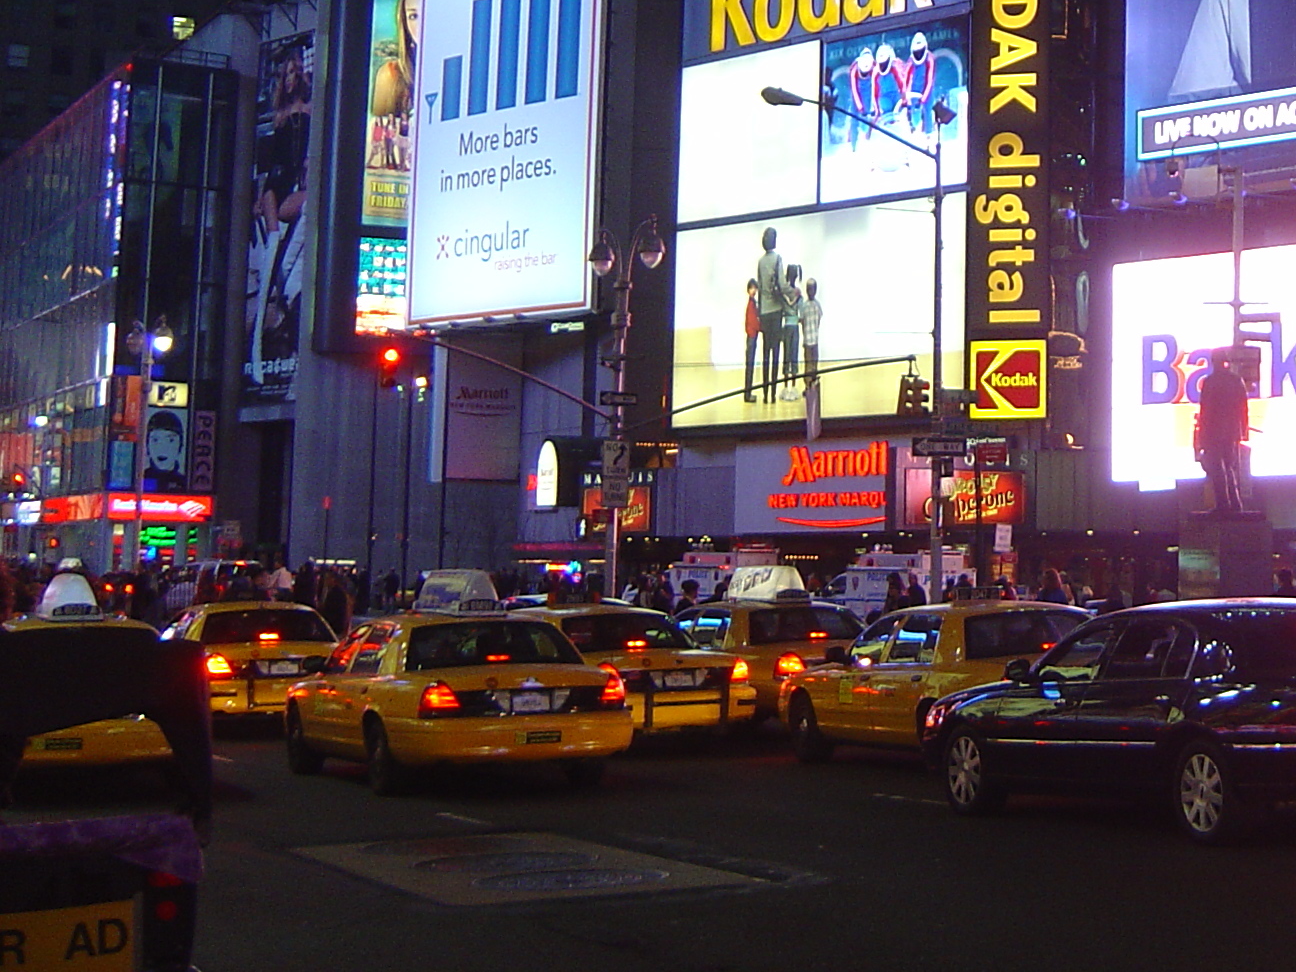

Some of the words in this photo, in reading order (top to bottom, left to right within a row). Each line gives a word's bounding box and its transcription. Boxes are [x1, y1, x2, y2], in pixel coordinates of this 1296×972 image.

[458, 129, 498, 158] More
[503, 123, 539, 153] bars
[1154, 117, 1192, 145] LIVE
[1192, 112, 1241, 139] NOW
[1244, 105, 1275, 131] ON
[440, 168, 453, 193] in
[456, 167, 497, 190] more
[500, 155, 557, 190] places.
[453, 221, 530, 262] cingular
[974, 131, 1041, 324] digital
[494, 256, 523, 273] raising
[524, 252, 539, 267] the
[541, 251, 557, 266] bar
[455, 386, 510, 401] Marriott
[990, 372, 1038, 387] Kodak
[781, 439, 889, 486] Marriott
[767, 493, 800, 509] NEW
[800, 491, 838, 508] YORK
[65, 917, 128, 962] AD
